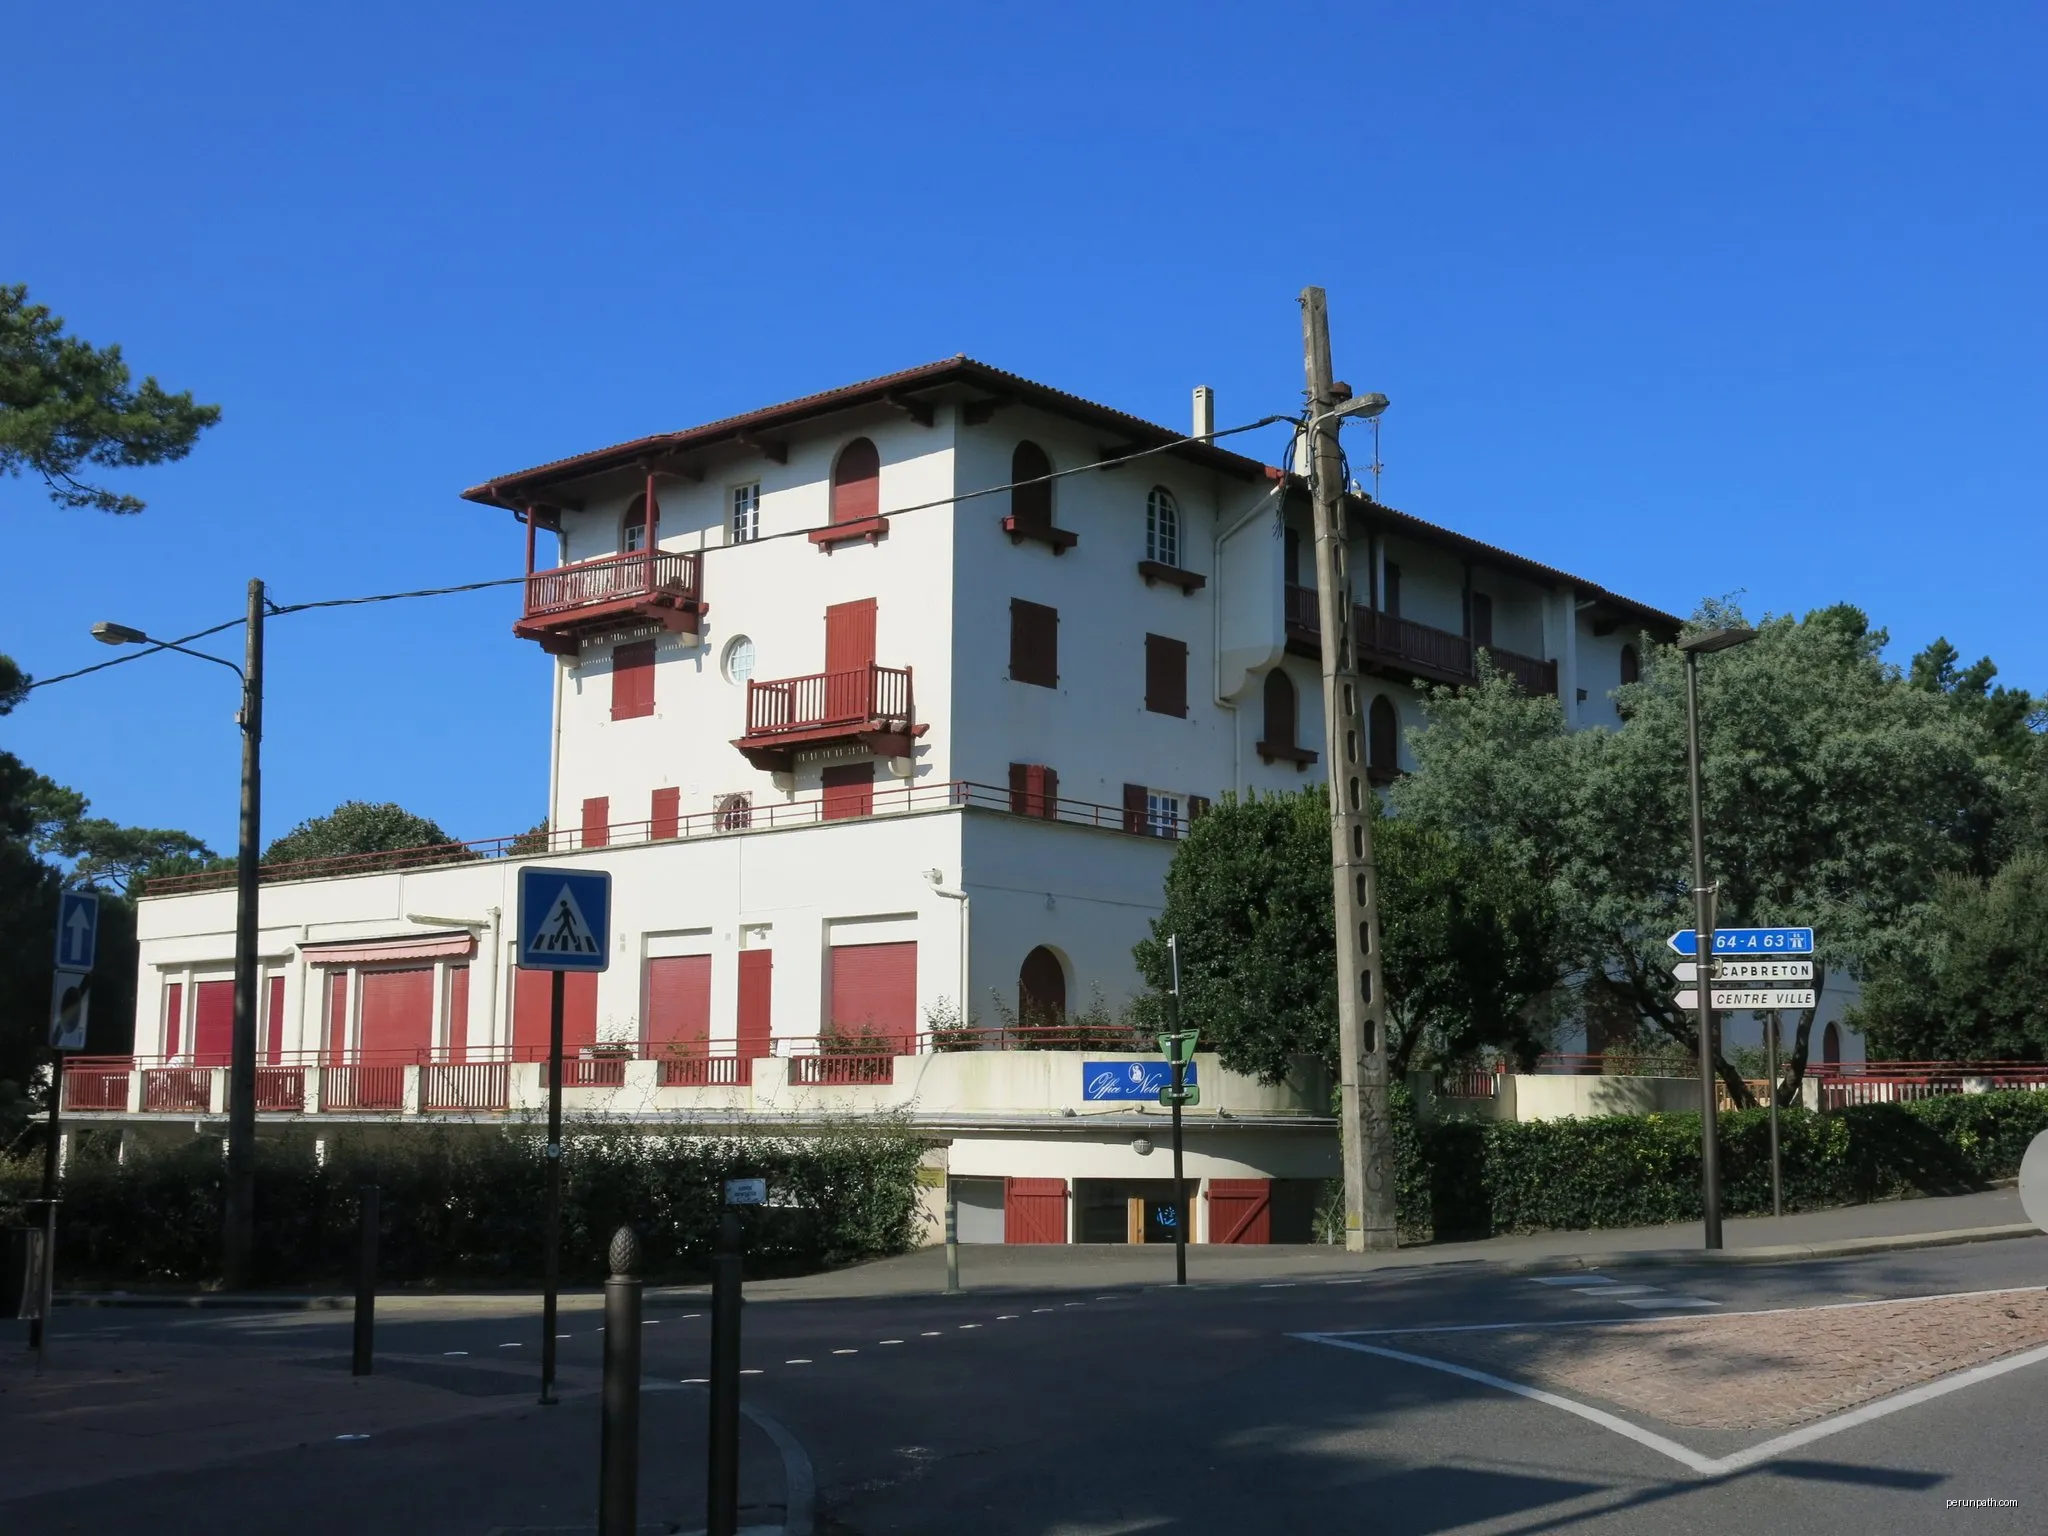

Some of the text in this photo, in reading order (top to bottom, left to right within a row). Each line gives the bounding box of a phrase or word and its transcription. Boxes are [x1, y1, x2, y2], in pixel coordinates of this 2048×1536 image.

[1721, 965, 1810, 977] CAPBRETON
[1716, 993, 1812, 1005] CENTRE VILLE
[1088, 1071, 1121, 1099] Office
